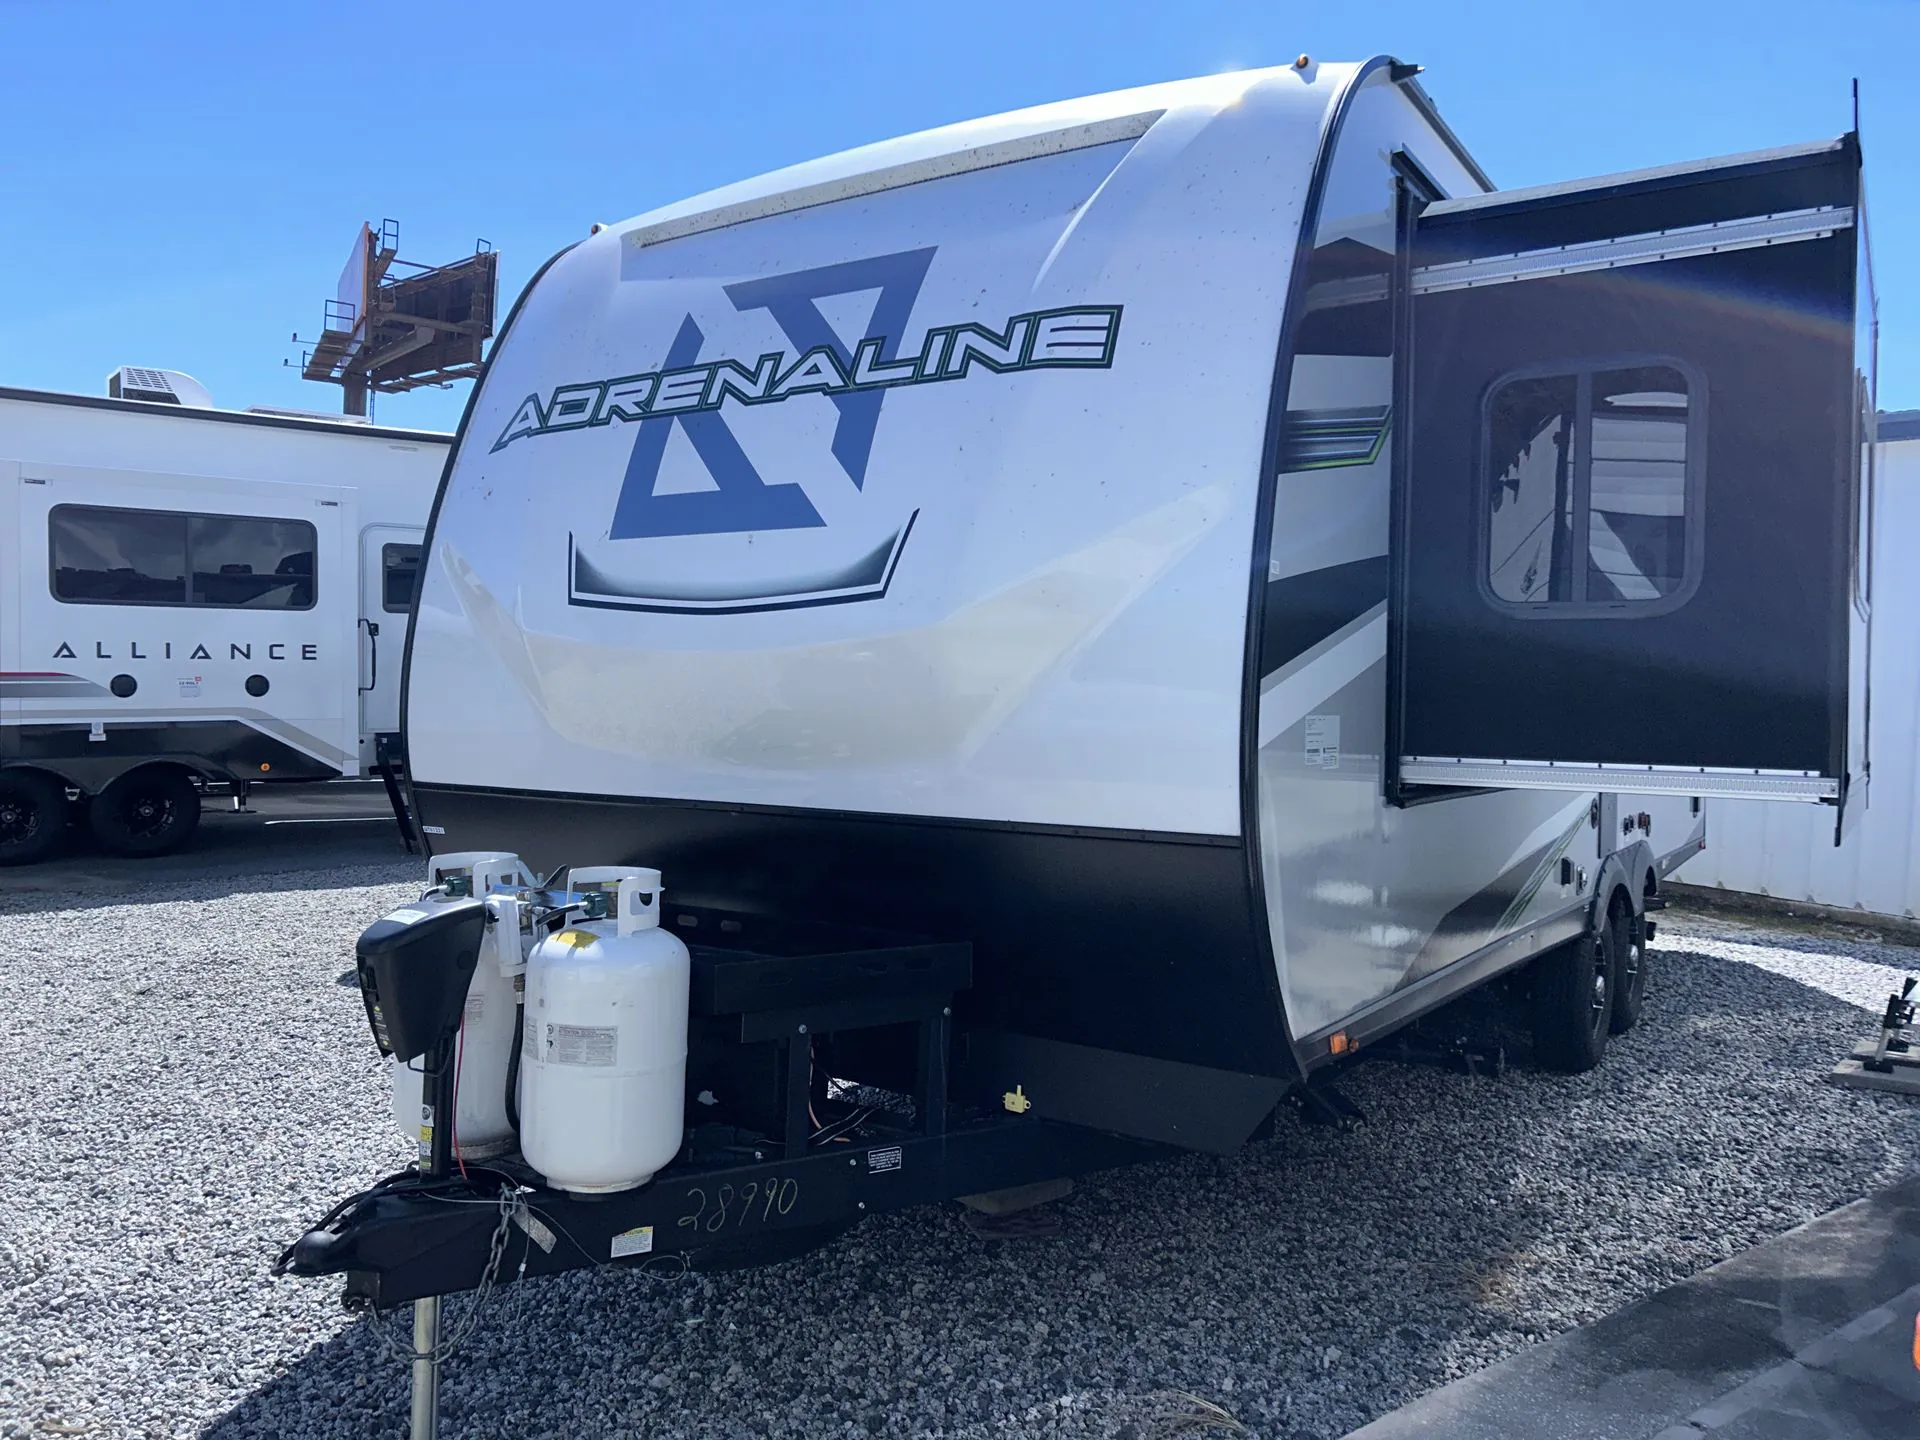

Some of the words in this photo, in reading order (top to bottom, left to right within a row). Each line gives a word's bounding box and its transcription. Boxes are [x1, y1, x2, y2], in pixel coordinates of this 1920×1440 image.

[488, 304, 1124, 455] ADRENALINE
[52, 641, 318, 660] ALLIANCE
[677, 1177, 798, 1232] 28990
